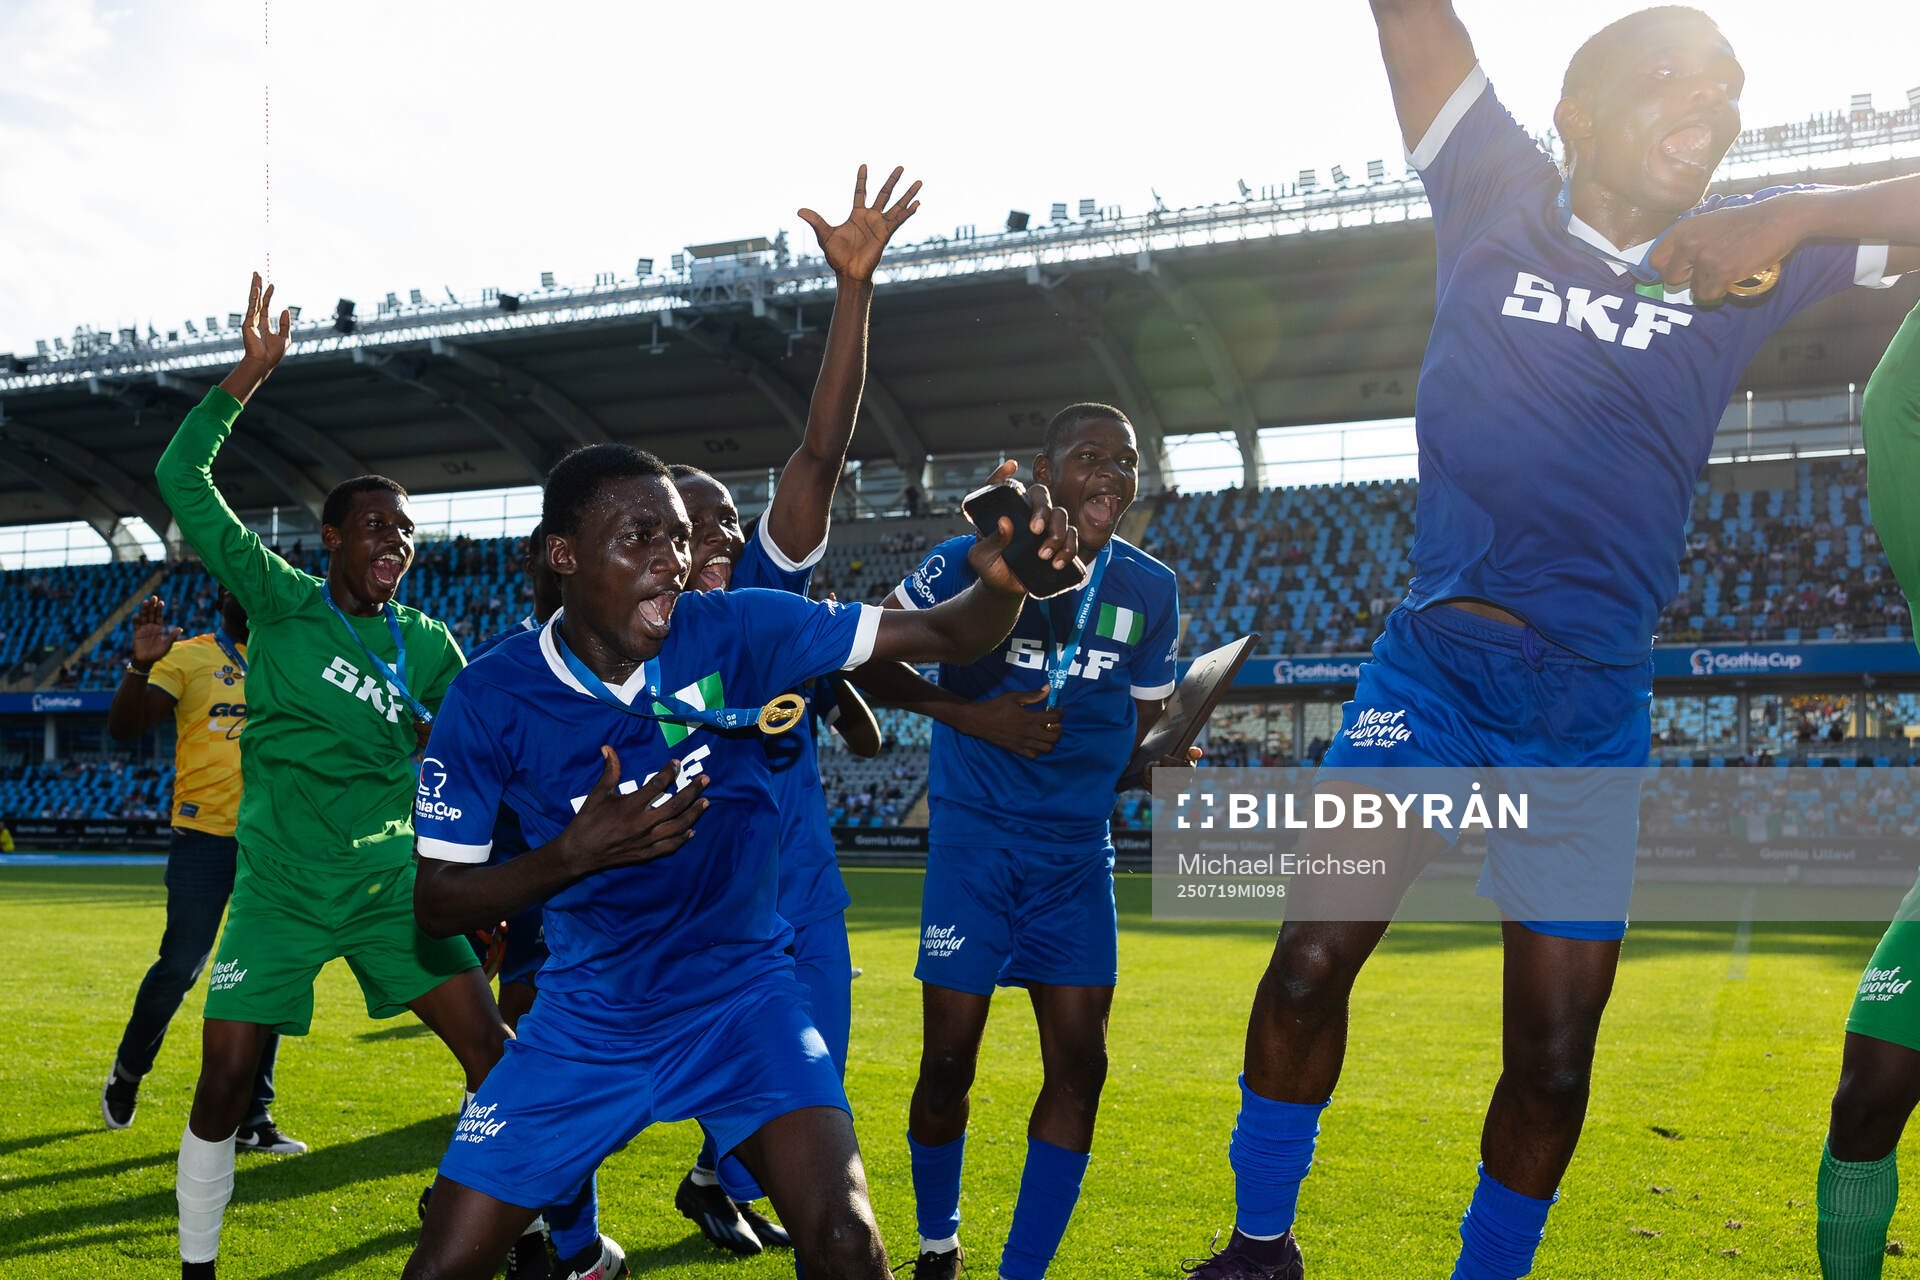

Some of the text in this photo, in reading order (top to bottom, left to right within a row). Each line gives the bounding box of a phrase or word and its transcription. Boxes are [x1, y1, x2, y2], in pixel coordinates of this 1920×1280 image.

[1501, 271, 1693, 350] SKF
[1352, 707, 1406, 729] Meet
[1350, 723, 1412, 742] world
[1375, 738, 1398, 748] SKF
[925, 924, 956, 939] Meet
[925, 936, 966, 950] world
[468, 1134, 486, 1143] SKF
